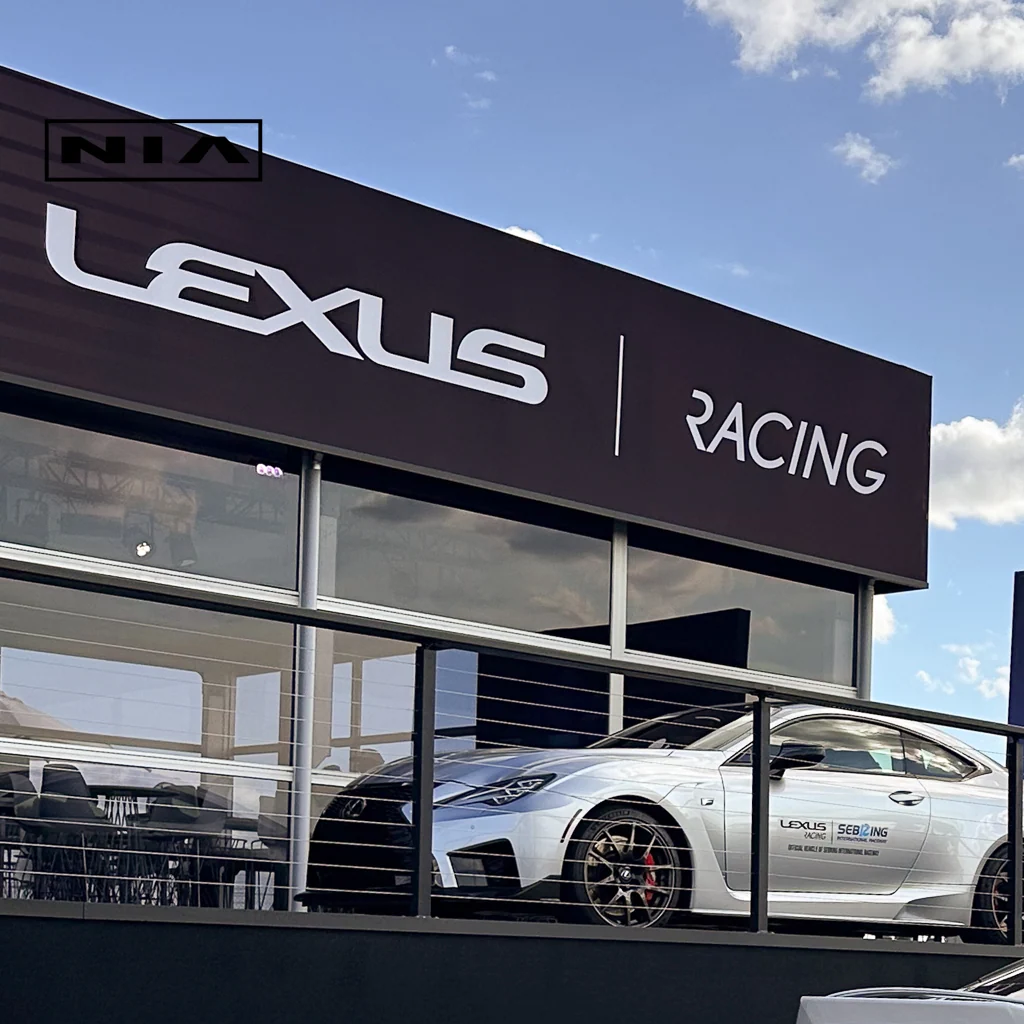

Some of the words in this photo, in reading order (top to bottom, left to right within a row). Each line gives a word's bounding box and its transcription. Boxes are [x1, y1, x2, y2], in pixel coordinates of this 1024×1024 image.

[45, 202, 549, 405] LEXUS
[685, 389, 888, 495] RACING
[780, 819, 827, 832] LEXUS
[803, 831, 827, 841] RACING
